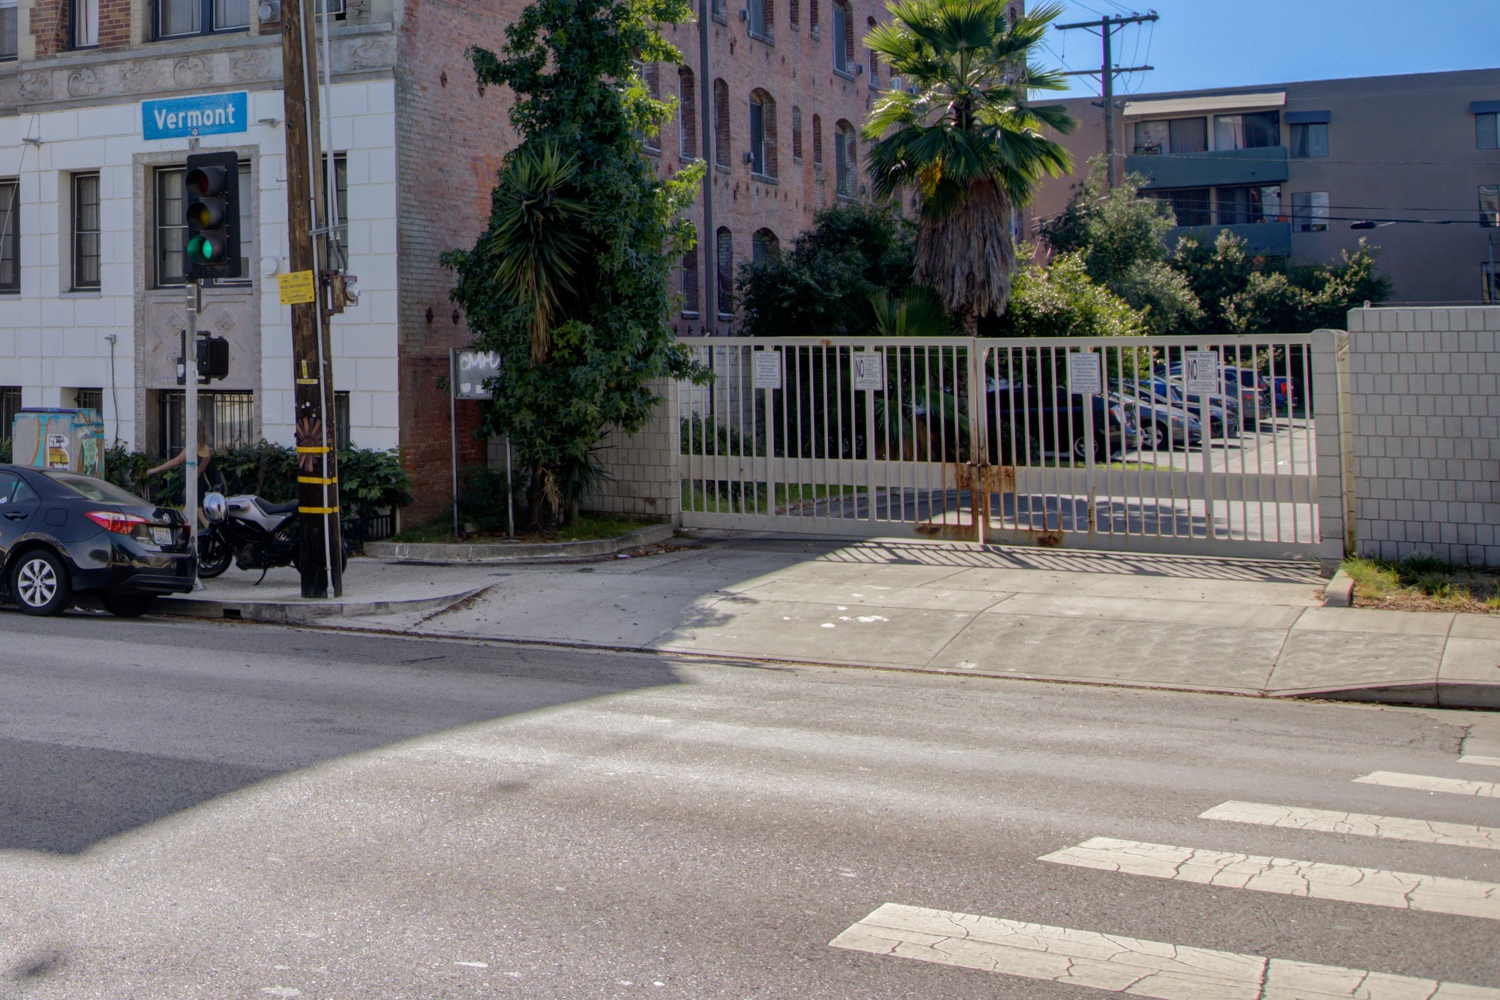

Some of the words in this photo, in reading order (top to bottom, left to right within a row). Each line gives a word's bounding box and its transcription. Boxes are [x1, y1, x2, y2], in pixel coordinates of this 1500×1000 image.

[153, 103, 236, 130] Vermont
[855, 359, 864, 378] NO
[1187, 359, 1198, 380] NO
